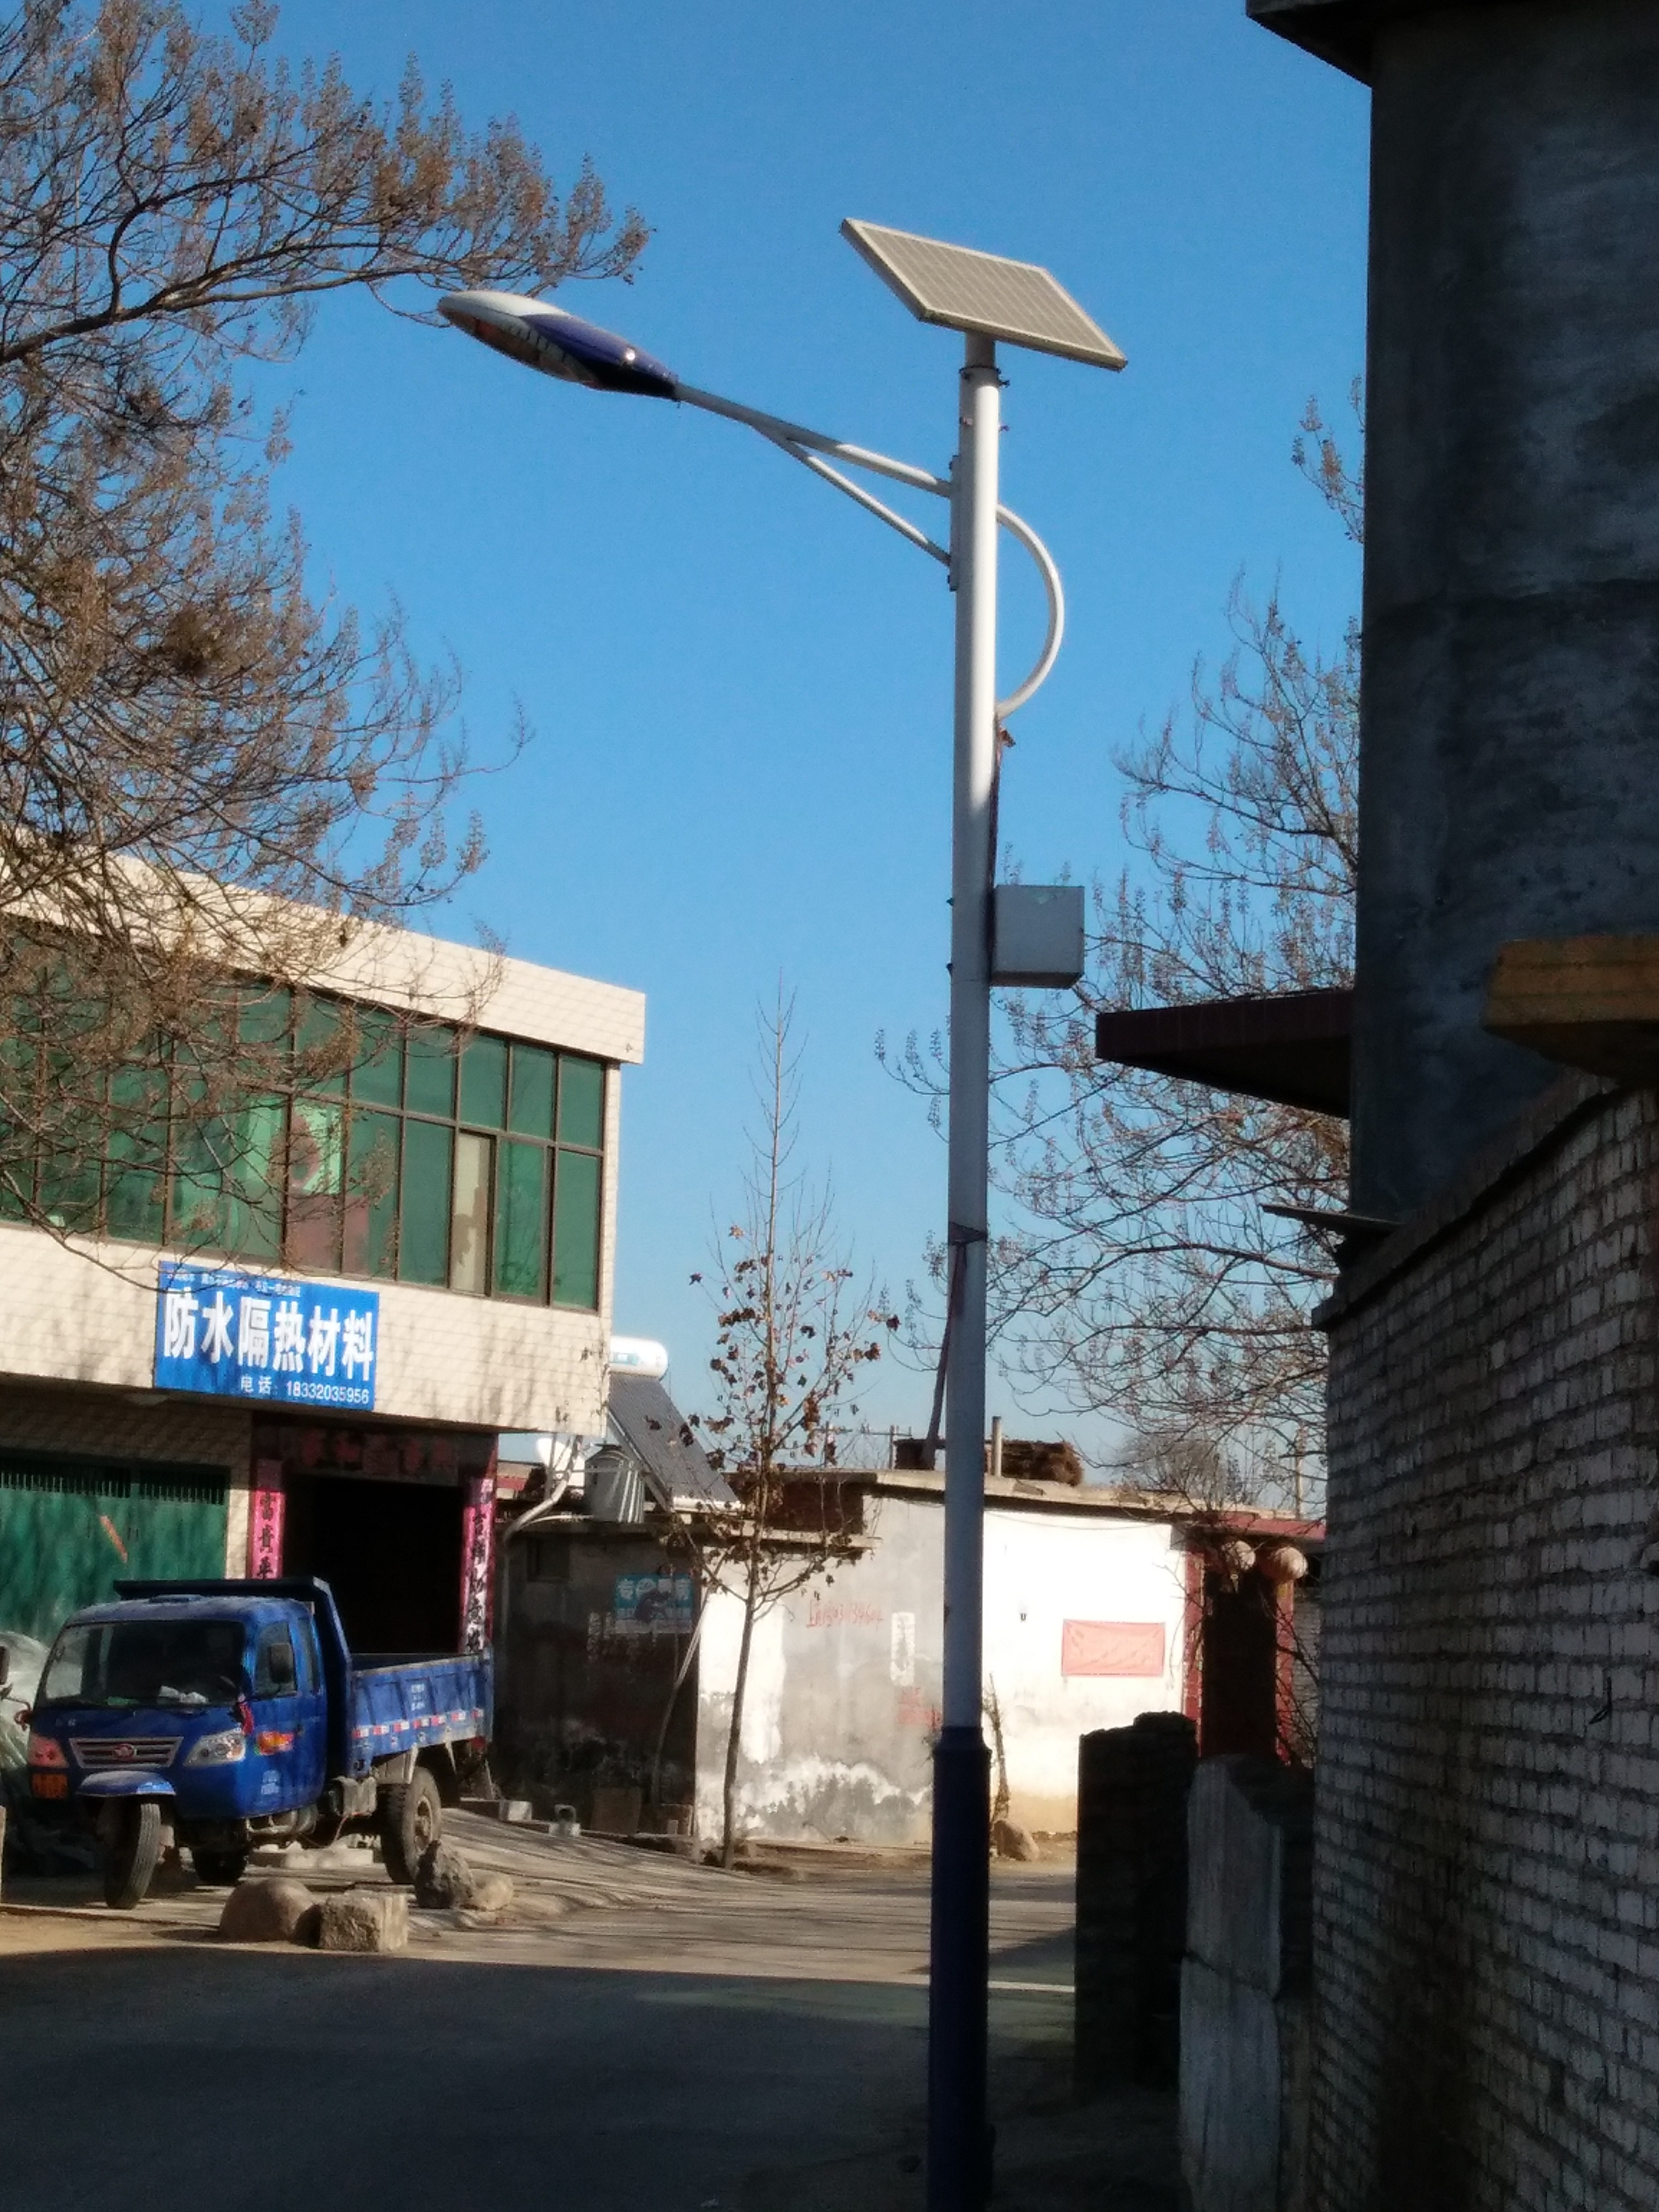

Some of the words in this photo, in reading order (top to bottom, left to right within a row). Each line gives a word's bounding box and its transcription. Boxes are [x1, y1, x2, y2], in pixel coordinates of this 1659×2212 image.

[163, 1287, 373, 1381] 防水隔热材料
